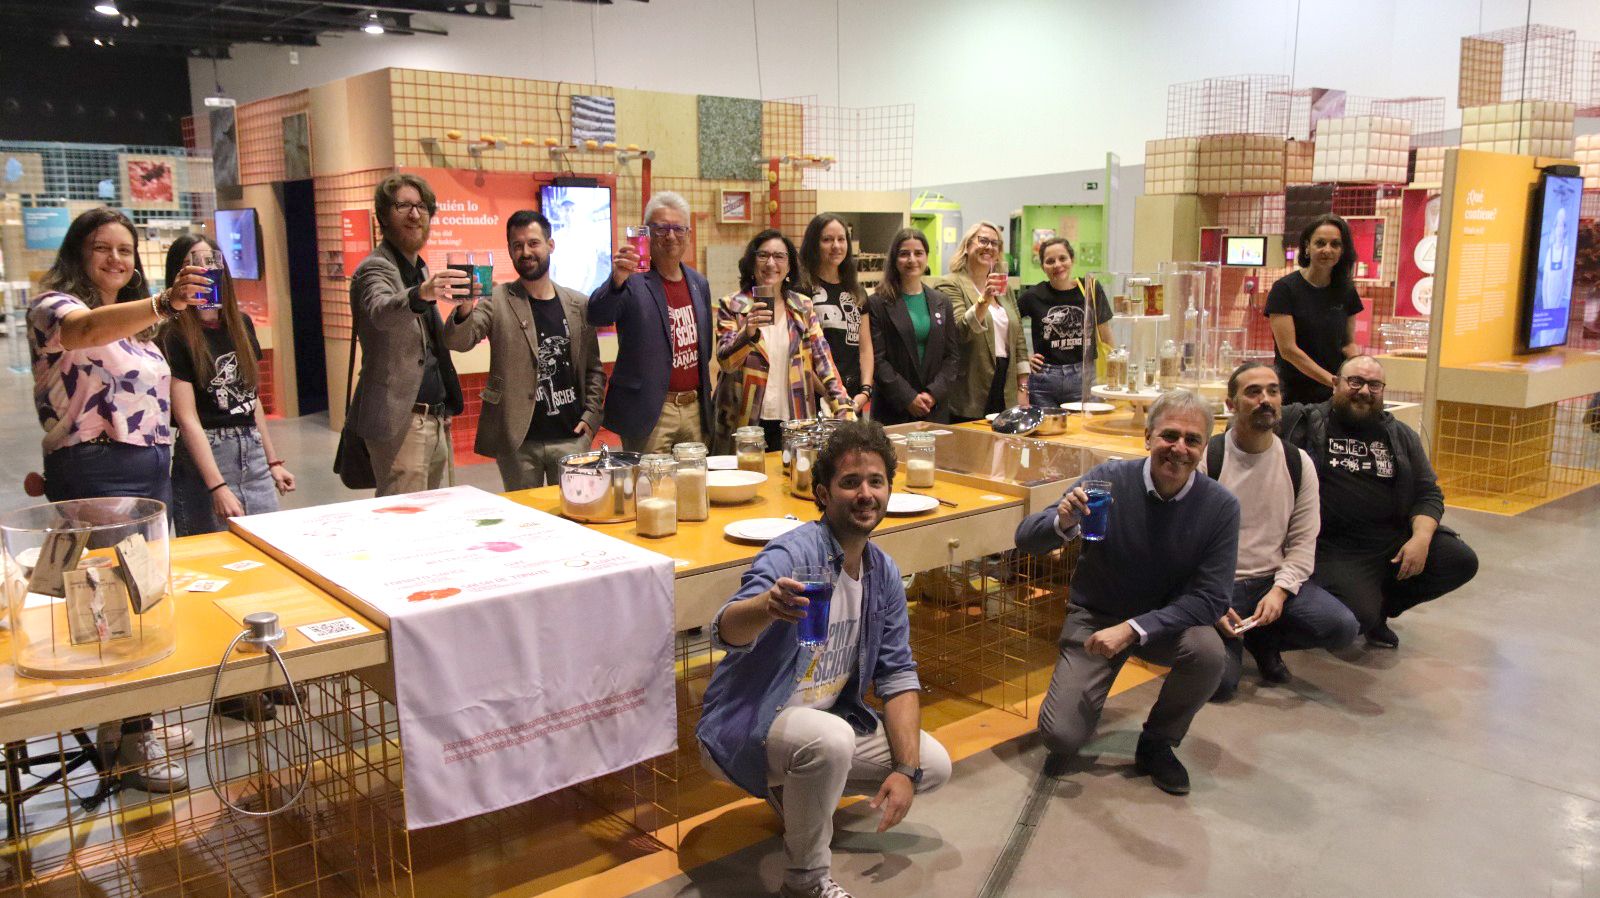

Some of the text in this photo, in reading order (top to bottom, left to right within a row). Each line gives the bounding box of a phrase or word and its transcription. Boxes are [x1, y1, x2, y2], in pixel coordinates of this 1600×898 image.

[467, 199, 479, 212] lo
[442, 214, 500, 226] cocinado?
[1464, 207, 1498, 221] contiene?
[674, 304, 695, 327] PINT
